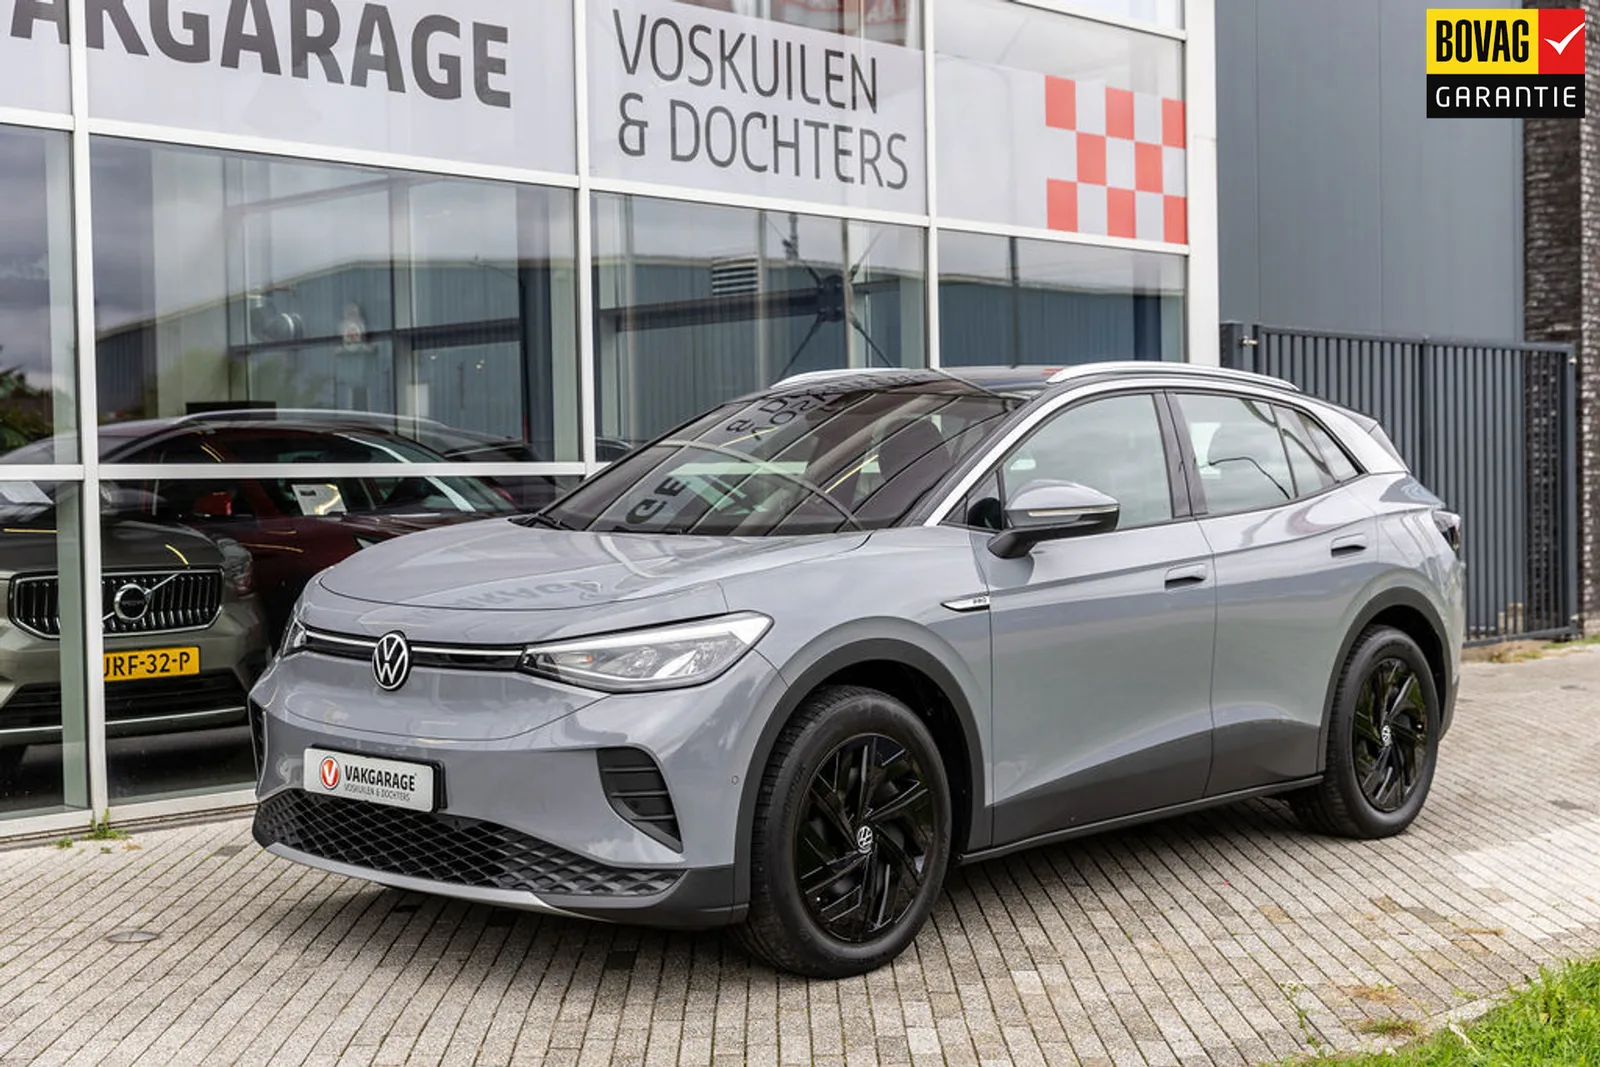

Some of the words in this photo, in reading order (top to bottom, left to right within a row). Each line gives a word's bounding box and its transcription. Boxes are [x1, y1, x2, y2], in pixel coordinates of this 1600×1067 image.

[612, 9, 877, 114] VOSKUILEN
[617, 92, 648, 156] &
[670, 99, 908, 190] DOCHTERS
[345, 765, 416, 792] VAKGARAGE
